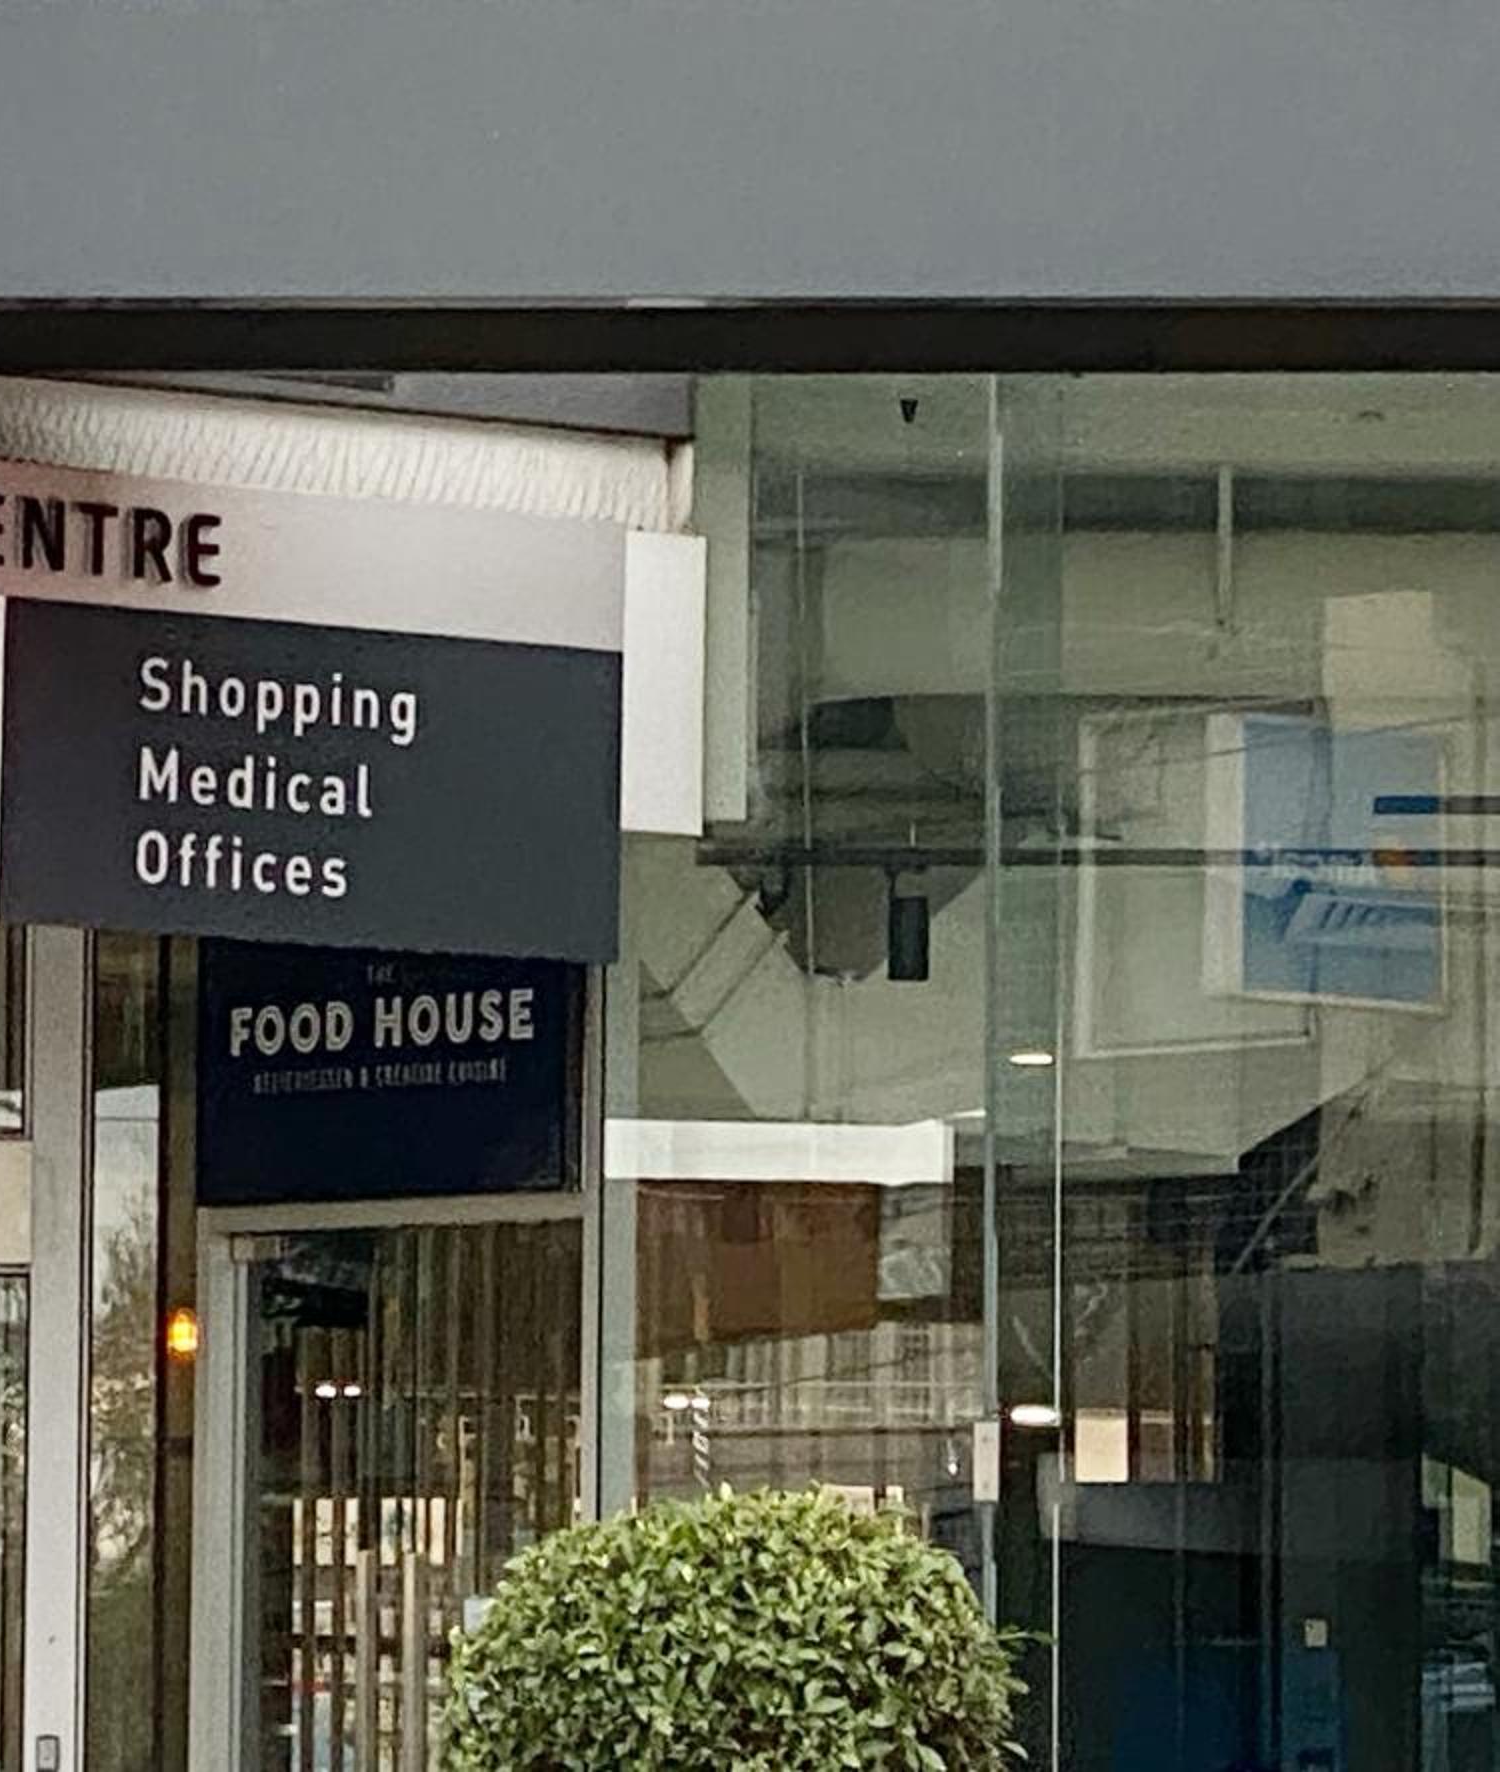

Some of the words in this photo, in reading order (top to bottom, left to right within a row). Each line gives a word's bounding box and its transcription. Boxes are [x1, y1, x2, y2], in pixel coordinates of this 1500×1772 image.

[139, 656, 418, 746] Shopping
[138, 746, 373, 818] Medical
[135, 829, 348, 898] Offices
[230, 1000, 355, 1058] FOOD
[373, 987, 535, 1049] HOUSE
